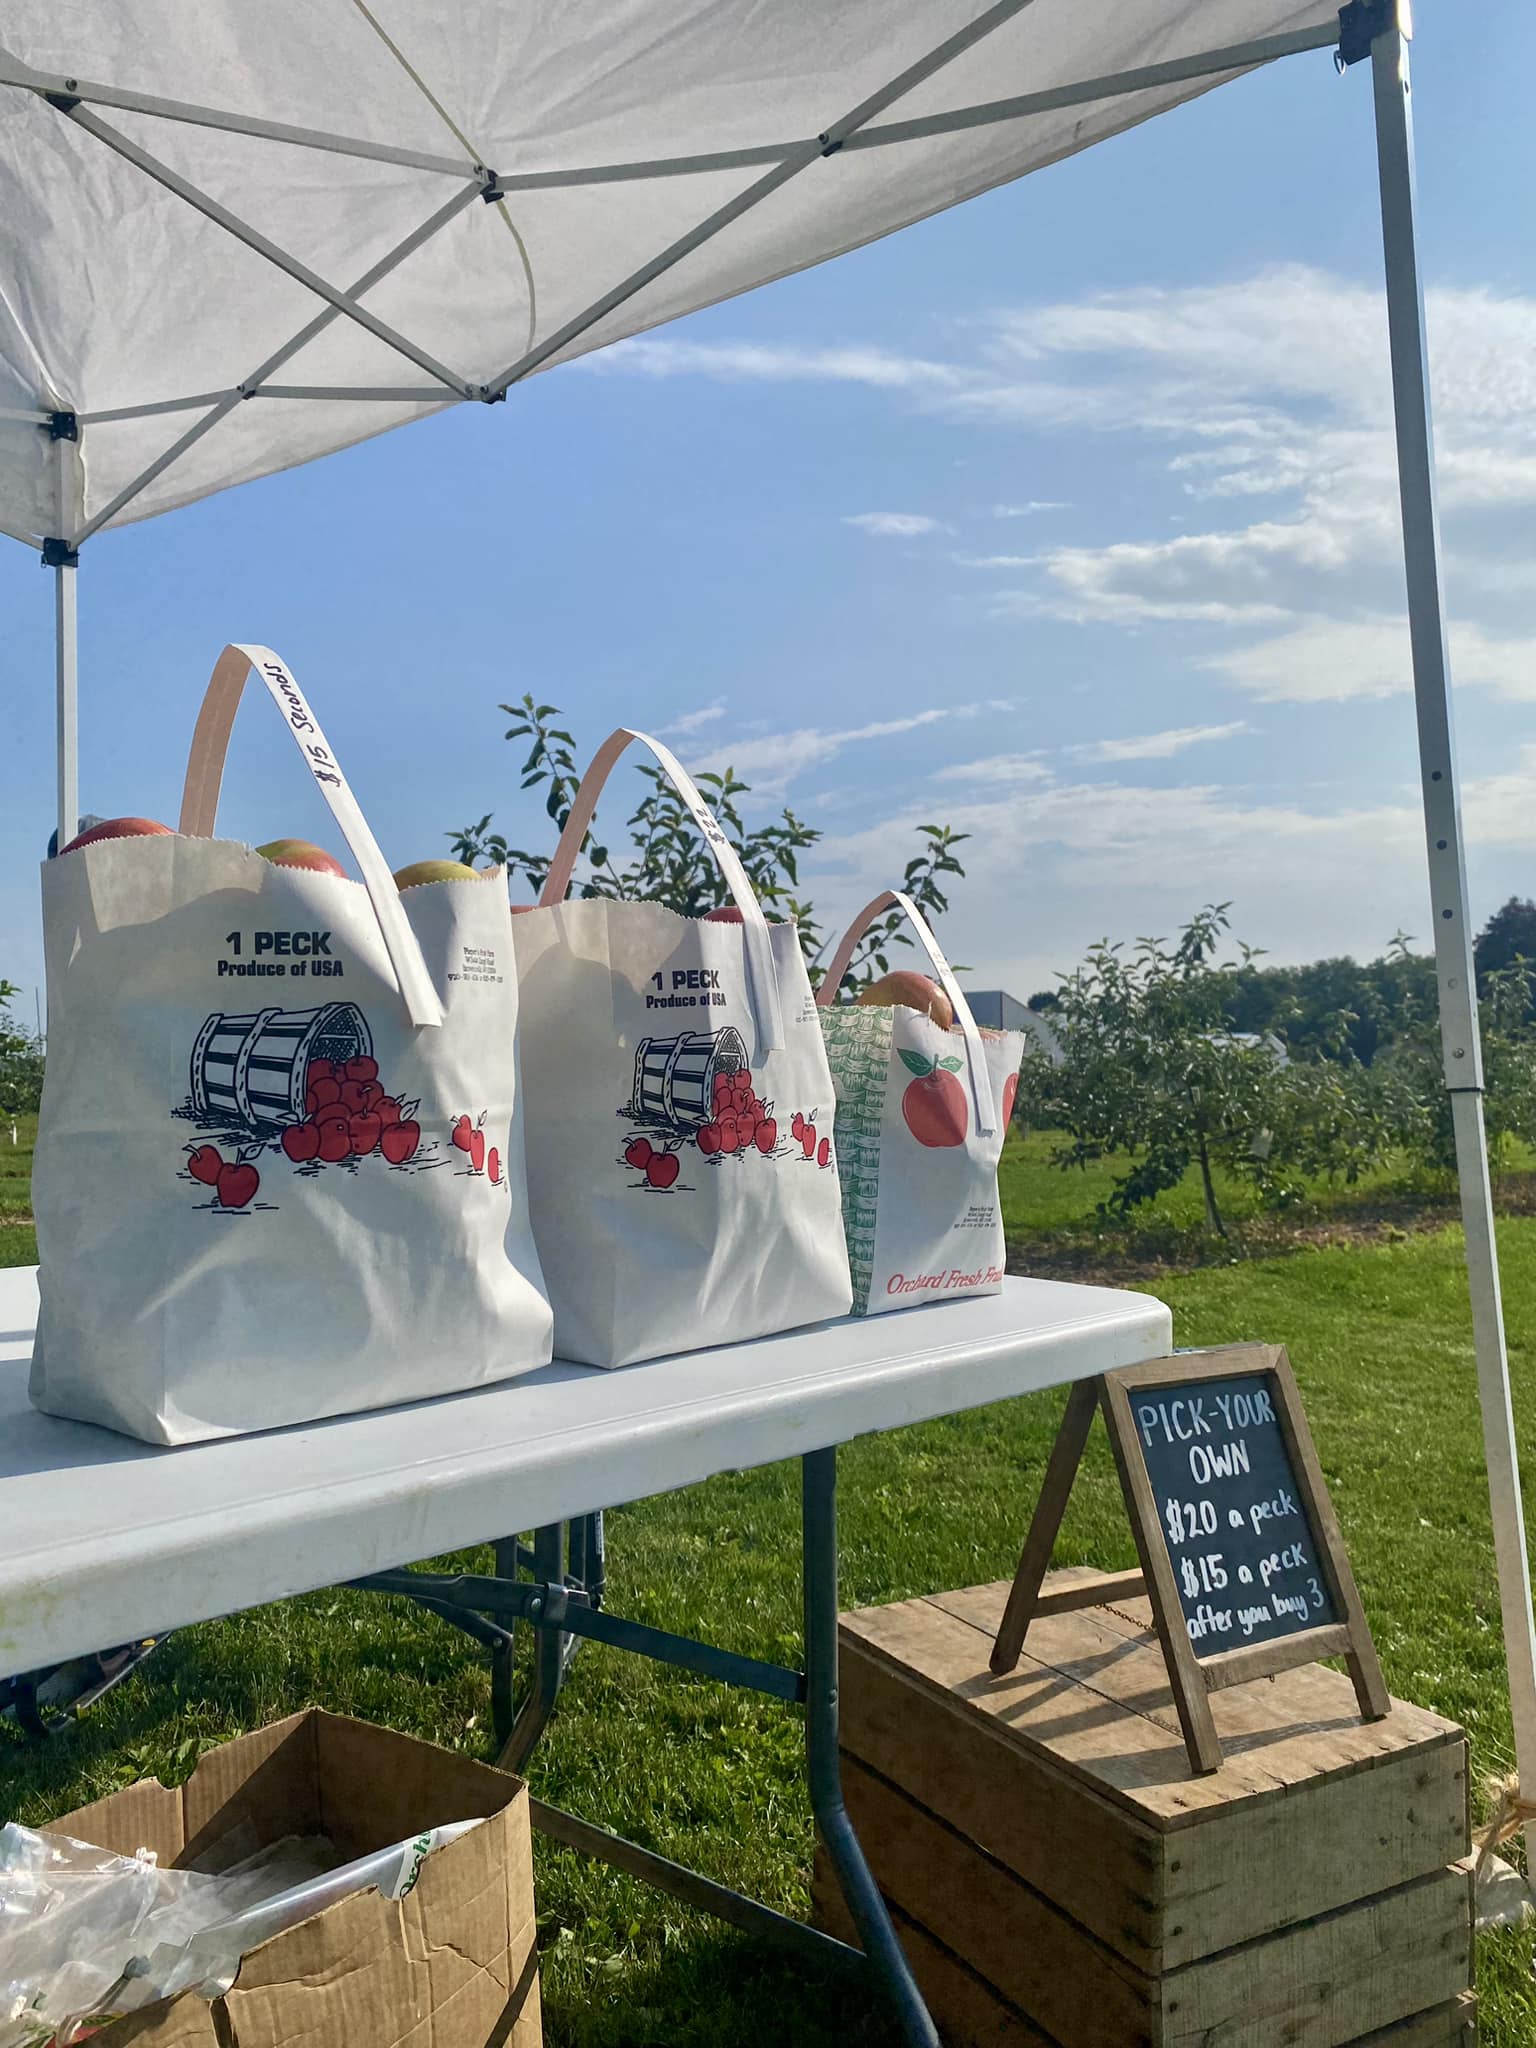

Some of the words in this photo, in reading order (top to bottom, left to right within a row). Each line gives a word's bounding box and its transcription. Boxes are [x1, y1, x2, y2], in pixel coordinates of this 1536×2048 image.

[264, 662, 314, 734] Seconds
[307, 744, 340, 788] $15
[225, 931, 241, 955] 1
[254, 931, 332, 955] PECK
[217, 960, 286, 976] Produce
[290, 960, 307, 976] of
[311, 960, 344, 976] USA
[651, 972, 663, 991] 1
[672, 969, 720, 990] PECK
[646, 993, 697, 1009] Produce
[699, 992, 710, 1006] of
[711, 992, 727, 1007] USA
[886, 1269, 947, 1295] Orchard
[943, 1268, 982, 1289] Fresh
[1137, 1388, 1277, 1447] PICK-YOUR
[1188, 1439, 1251, 1485] OWN
[1166, 1498, 1219, 1545] $20
[1228, 1509, 1245, 1529] a
[1249, 1488, 1299, 1536] peck
[1180, 1553, 1229, 1599] $15
[1238, 1566, 1254, 1584] a
[1258, 1542, 1309, 1588] peck
[1186, 1603, 1233, 1640] after
[1237, 1605, 1273, 1636] you
[1271, 1593, 1309, 1621] buy
[1305, 1577, 1325, 1608] 3
